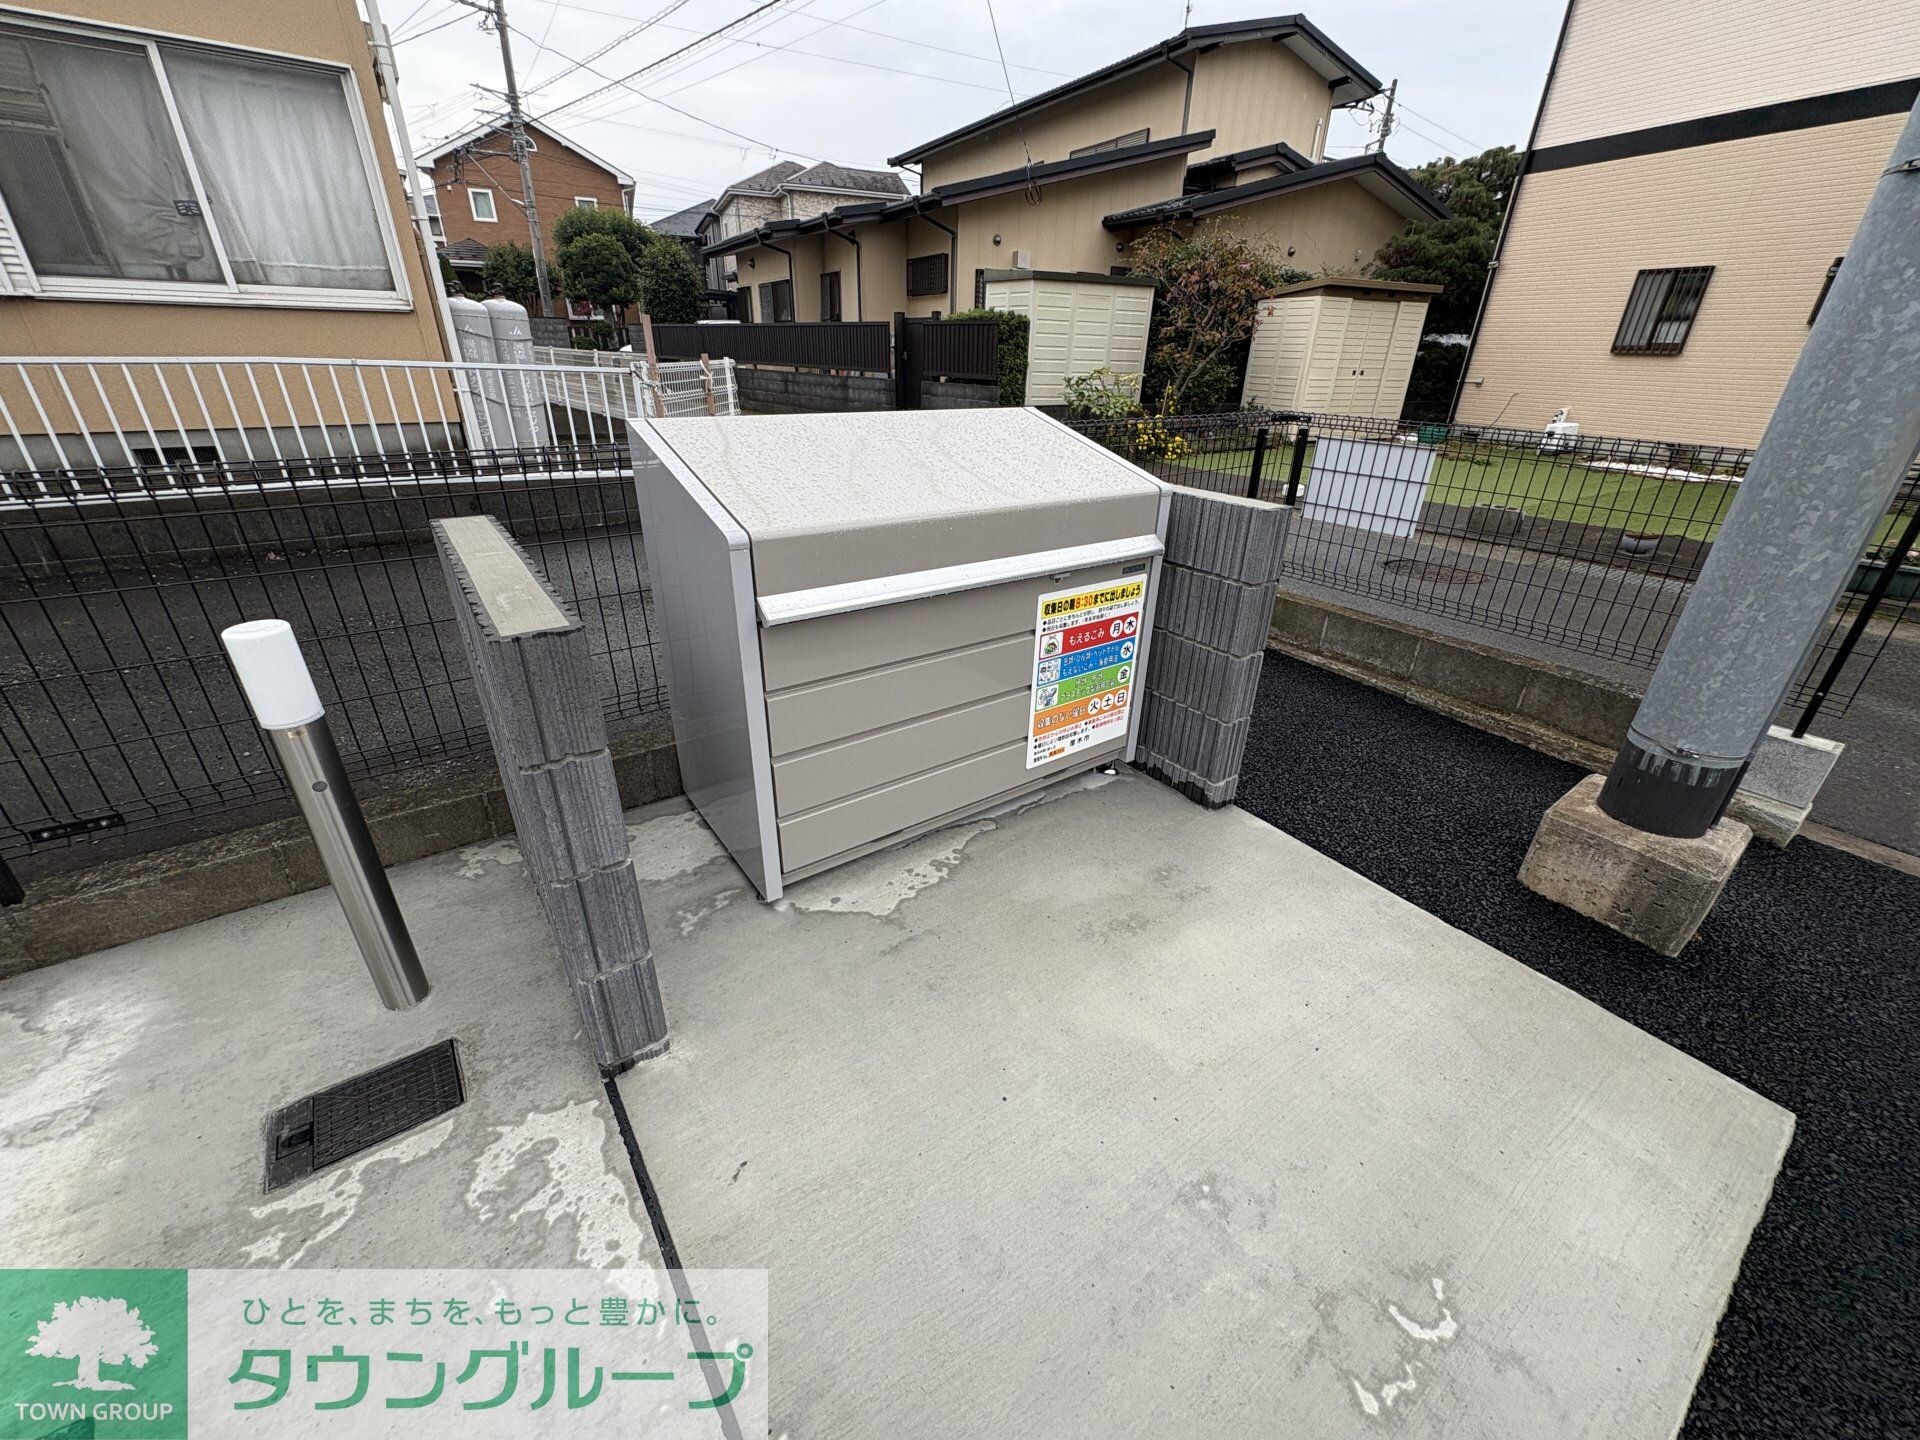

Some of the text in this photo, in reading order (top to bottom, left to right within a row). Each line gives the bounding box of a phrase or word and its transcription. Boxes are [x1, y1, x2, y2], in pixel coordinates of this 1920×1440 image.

[1044, 585, 1141, 616] 収集日の朝8:30までに出しましょう
[1069, 619, 1135, 646] もえるごみ 月 木
[1122, 645, 1131, 656] 水
[1120, 669, 1129, 680] 金
[1089, 701, 1099, 713] 火
[1103, 698, 1112, 709] 土
[1117, 692, 1125, 703] 日
[1070, 735, 1090, 747] 厚木市
